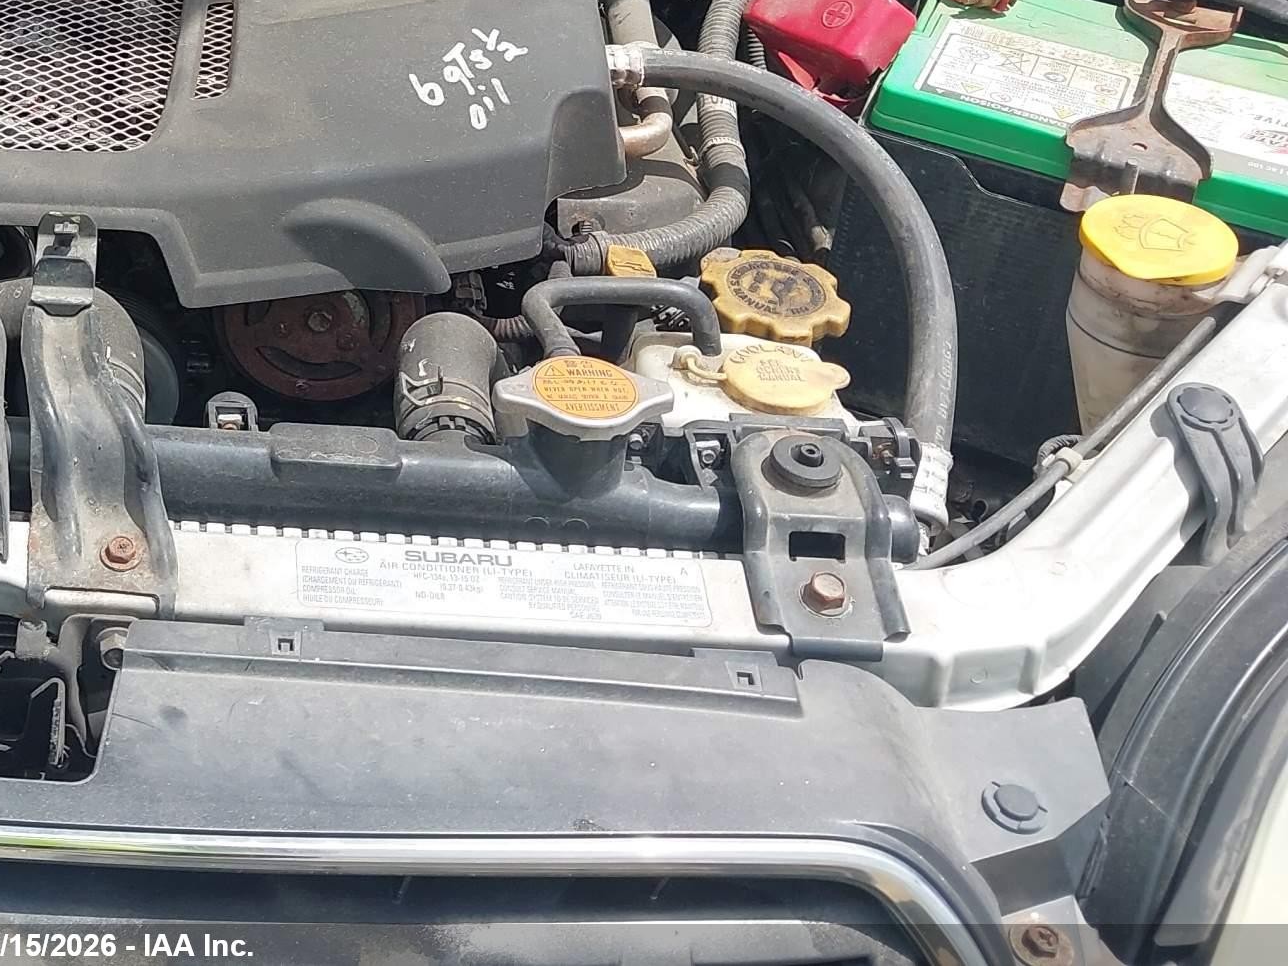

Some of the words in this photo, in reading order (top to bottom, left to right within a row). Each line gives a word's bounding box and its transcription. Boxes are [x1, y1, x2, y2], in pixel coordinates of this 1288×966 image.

[566, 368, 613, 378] WARNING
[404, 550, 513, 567] SUBARU
[379, 561, 399, 570] AIR
[402, 562, 479, 574] CONDITIONER
[573, 563, 622, 572] LAFAYETTE
[564, 570, 630, 582] CLIMATISEUR
